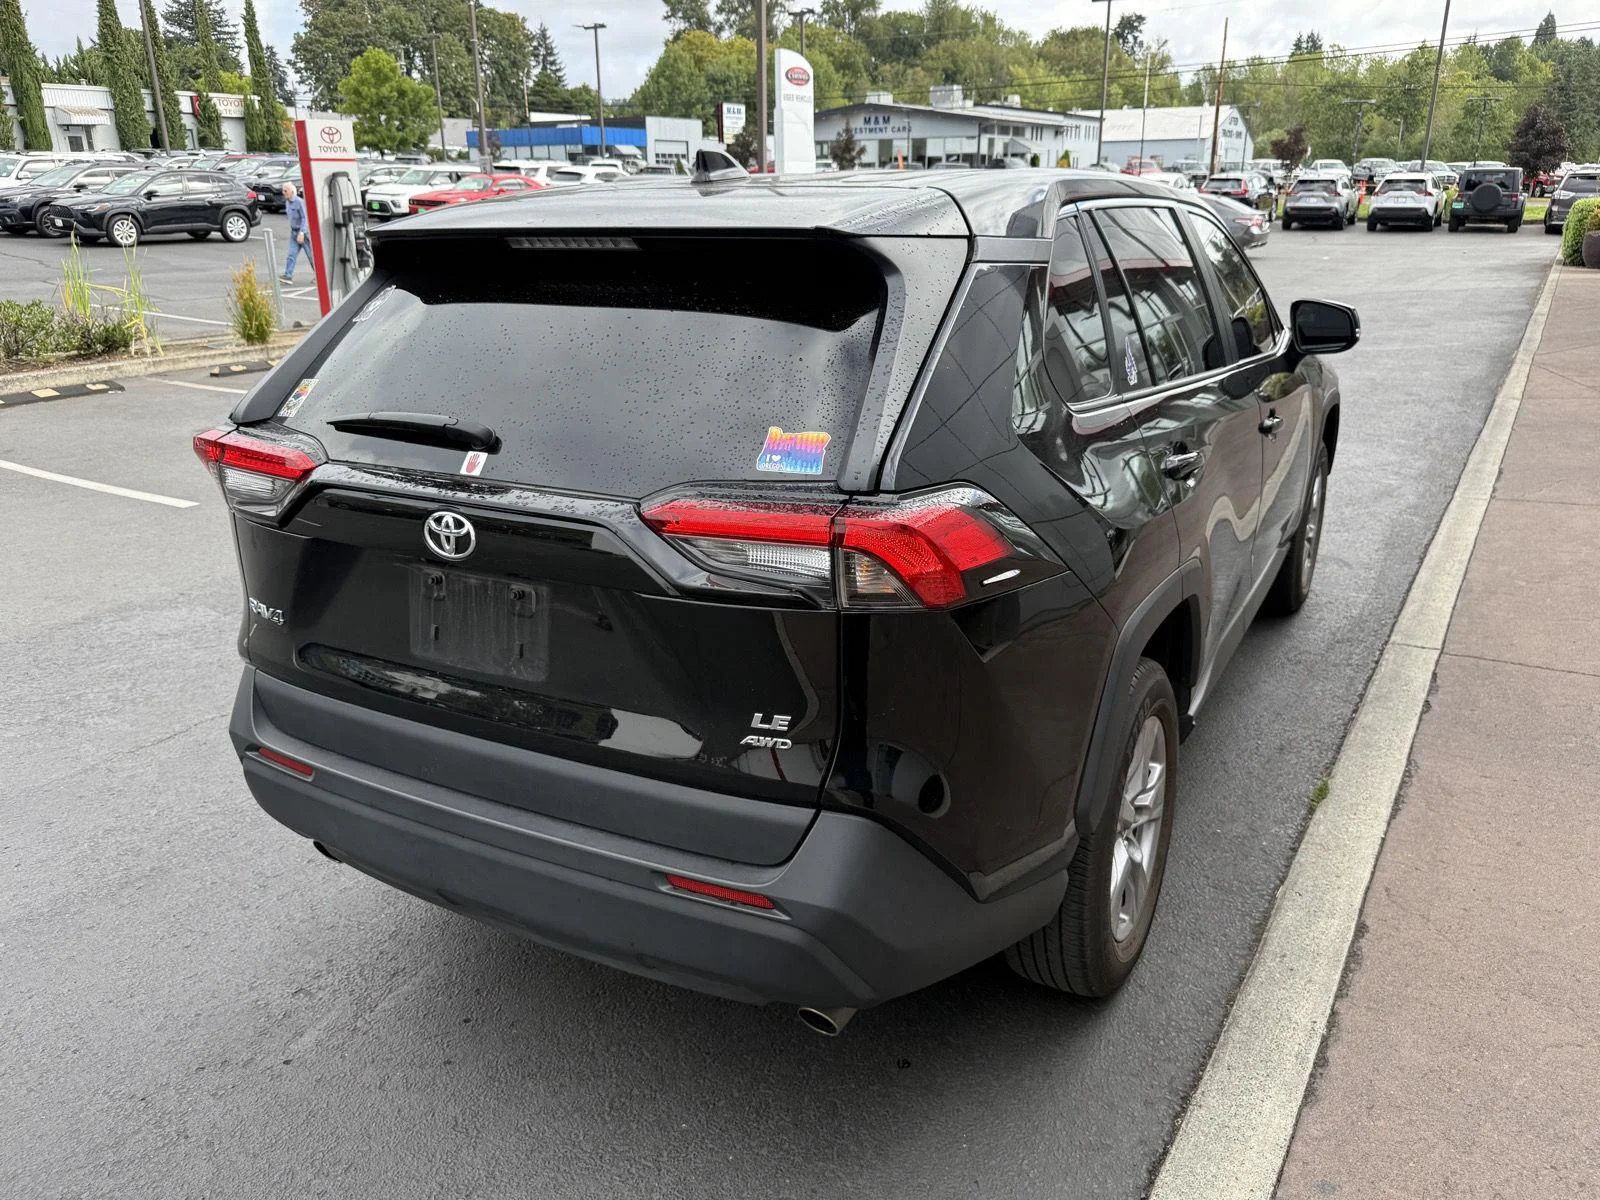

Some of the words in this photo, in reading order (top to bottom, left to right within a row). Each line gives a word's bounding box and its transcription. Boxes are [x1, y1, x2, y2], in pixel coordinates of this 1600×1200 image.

[218, 98, 245, 107] TOYOT
[249, 597, 284, 625] RAV4
[751, 712, 791, 731] LE
[740, 735, 792, 749] AWD
